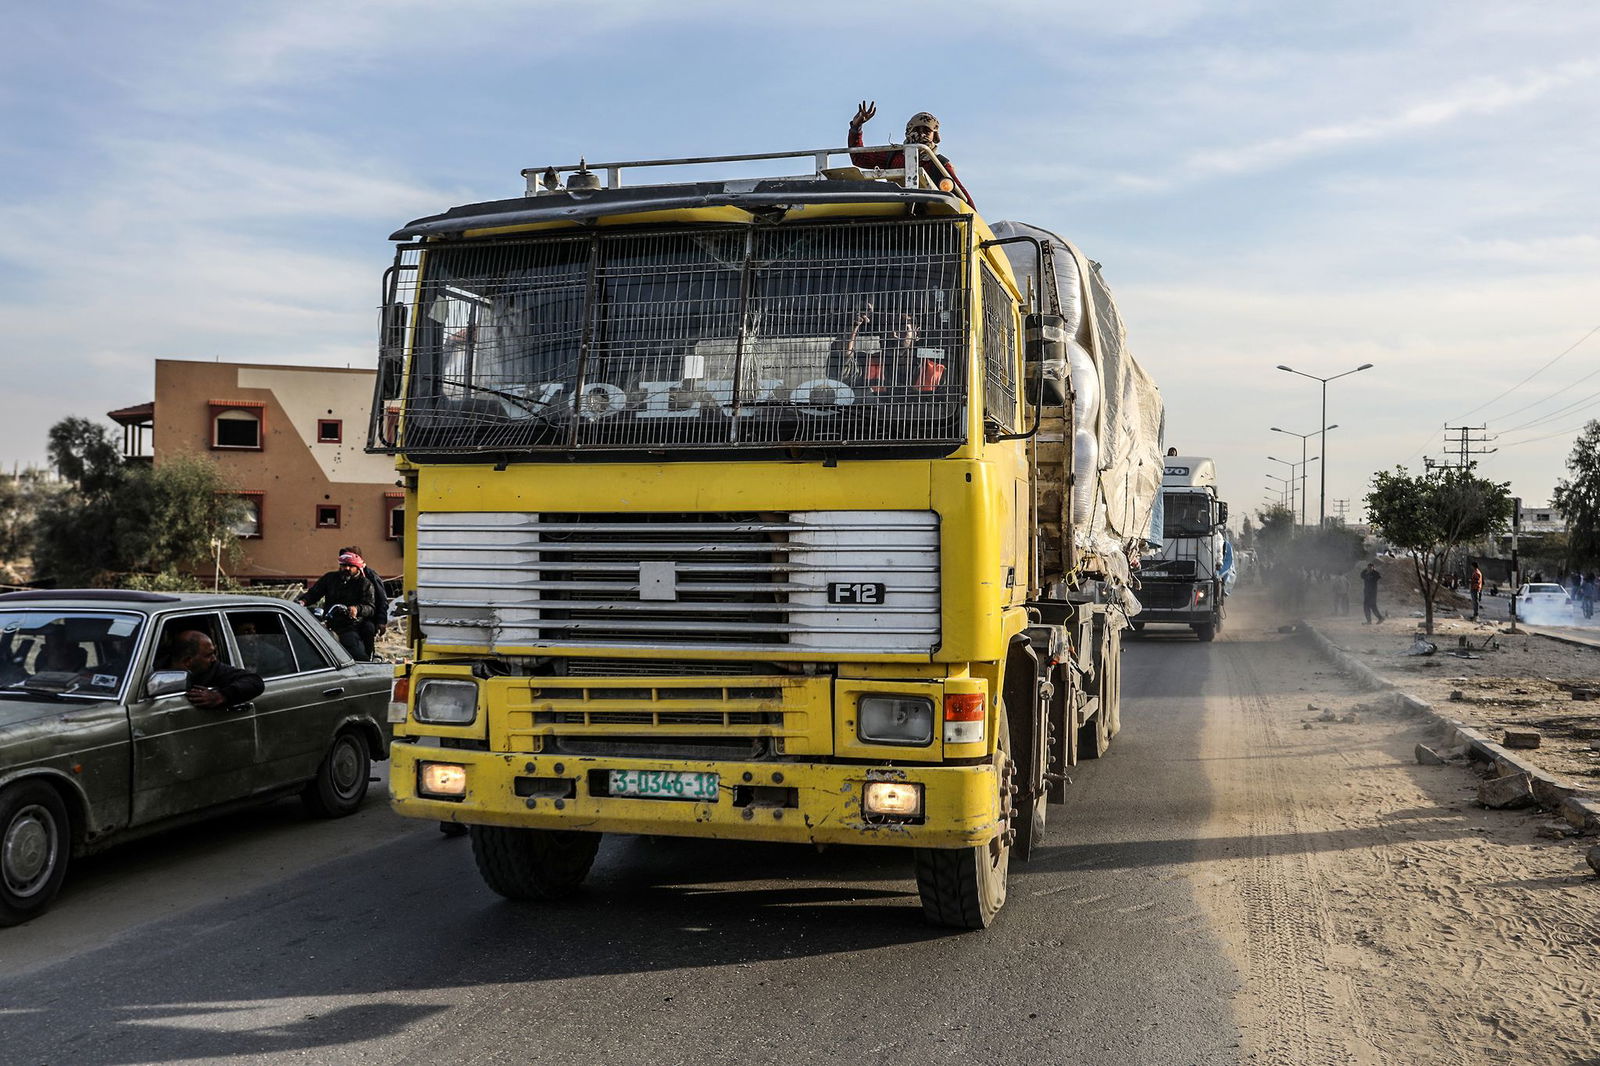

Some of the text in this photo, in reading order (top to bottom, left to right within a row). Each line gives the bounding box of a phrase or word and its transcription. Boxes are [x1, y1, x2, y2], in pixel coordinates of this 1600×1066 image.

[489, 378, 856, 421] VOLVO
[835, 583, 877, 603] F12
[616, 770, 718, 797] 3-0346-18
